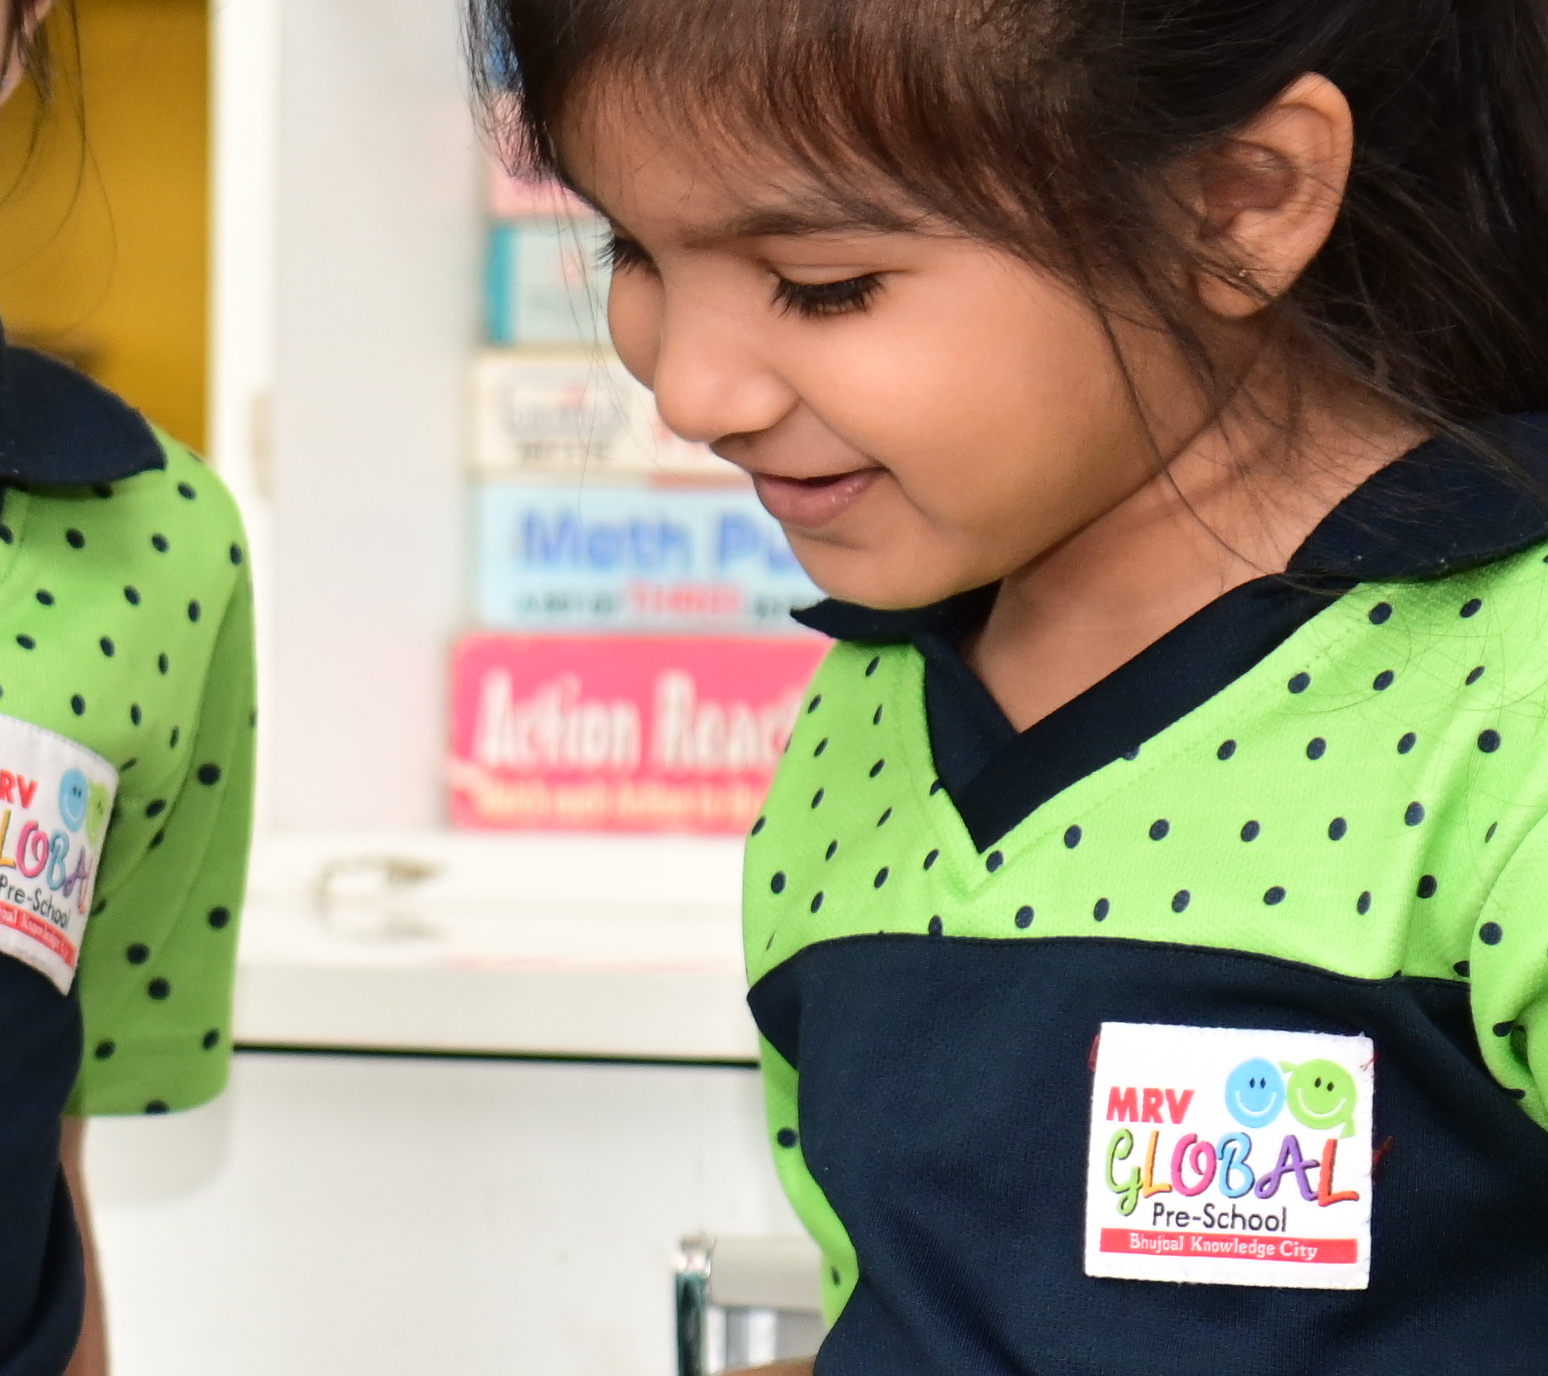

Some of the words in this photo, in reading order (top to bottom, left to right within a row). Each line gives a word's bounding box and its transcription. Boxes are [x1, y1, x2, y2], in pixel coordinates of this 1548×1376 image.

[476, 667, 642, 771] Action
[1106, 1085, 1195, 1124] MRV
[1105, 1127, 1360, 1216] GLOBAL
[1152, 1202, 1287, 1232] Pre-School
[1190, 1236, 1276, 1257] Knowledge
[1280, 1240, 1319, 1261] City
